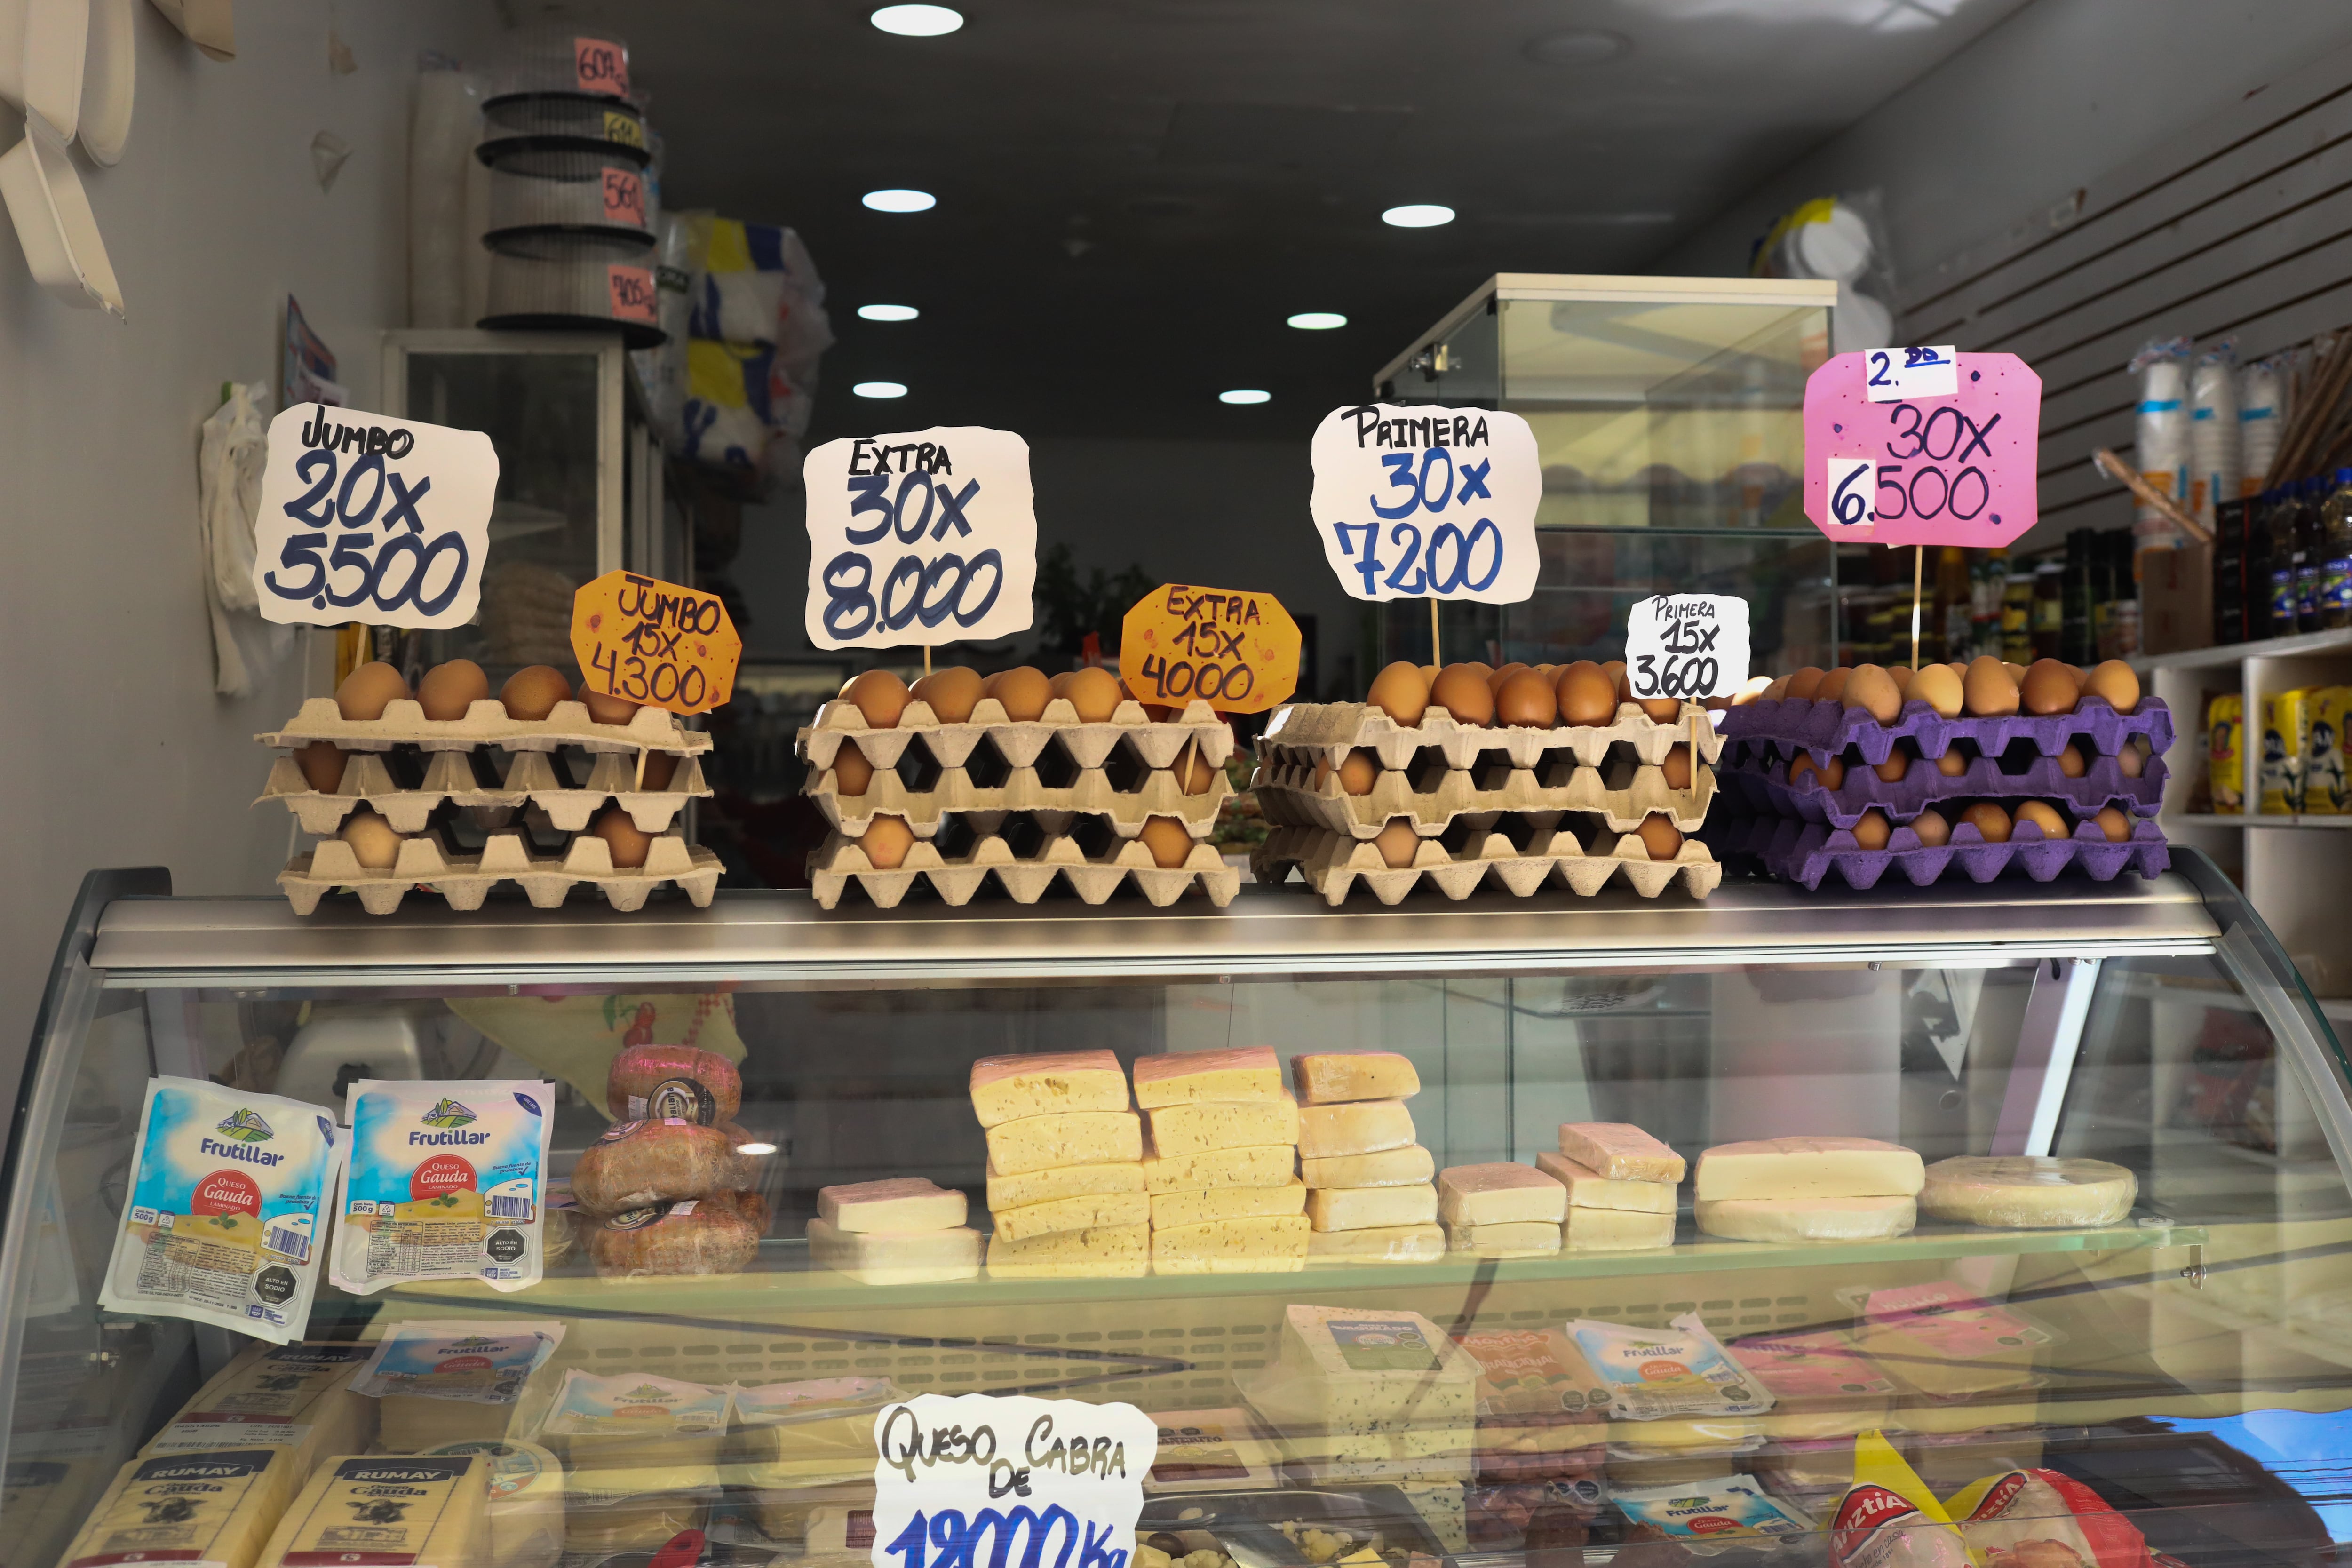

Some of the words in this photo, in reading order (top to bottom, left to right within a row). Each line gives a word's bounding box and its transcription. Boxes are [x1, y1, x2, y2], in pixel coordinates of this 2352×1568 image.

[302, 405, 414, 459] JUMBO
[1341, 406, 1489, 449] PRIMERA
[848, 438, 952, 476] EXTRA
[1333, 517, 1503, 595] 7200
[264, 531, 469, 616] 5.500
[618, 573, 720, 636] JUMBO
[823, 549, 1002, 640] 8.000
[1167, 586, 1260, 625] EXTRA
[1652, 595, 1715, 621] PRIMERA
[591, 641, 706, 707] 4.300
[1635, 654, 1718, 698] 3.600
[409, 1130, 490, 1146] Frutillar
[200, 1138, 284, 1167] Frutillar
[421, 1170, 468, 1183] Gauda
[204, 1184, 253, 1206] Gauda
[210, 1202, 240, 1211] LAMINADO
[437, 1346, 509, 1355] Frutillar
[1623, 1346, 1684, 1358] Frutillar
[1645, 1366, 1682, 1375] Gauda
[882, 1405, 996, 1483] QUESO
[988, 1458, 1032, 1499] DE
[1025, 1414, 1126, 1480] CABRA
[151, 1467, 241, 1479] RUMAY
[1666, 1505, 1729, 1517] Frutillar
[1694, 1520, 1732, 1529] Gauda
[1883, 1547, 1893, 1560] 1894
